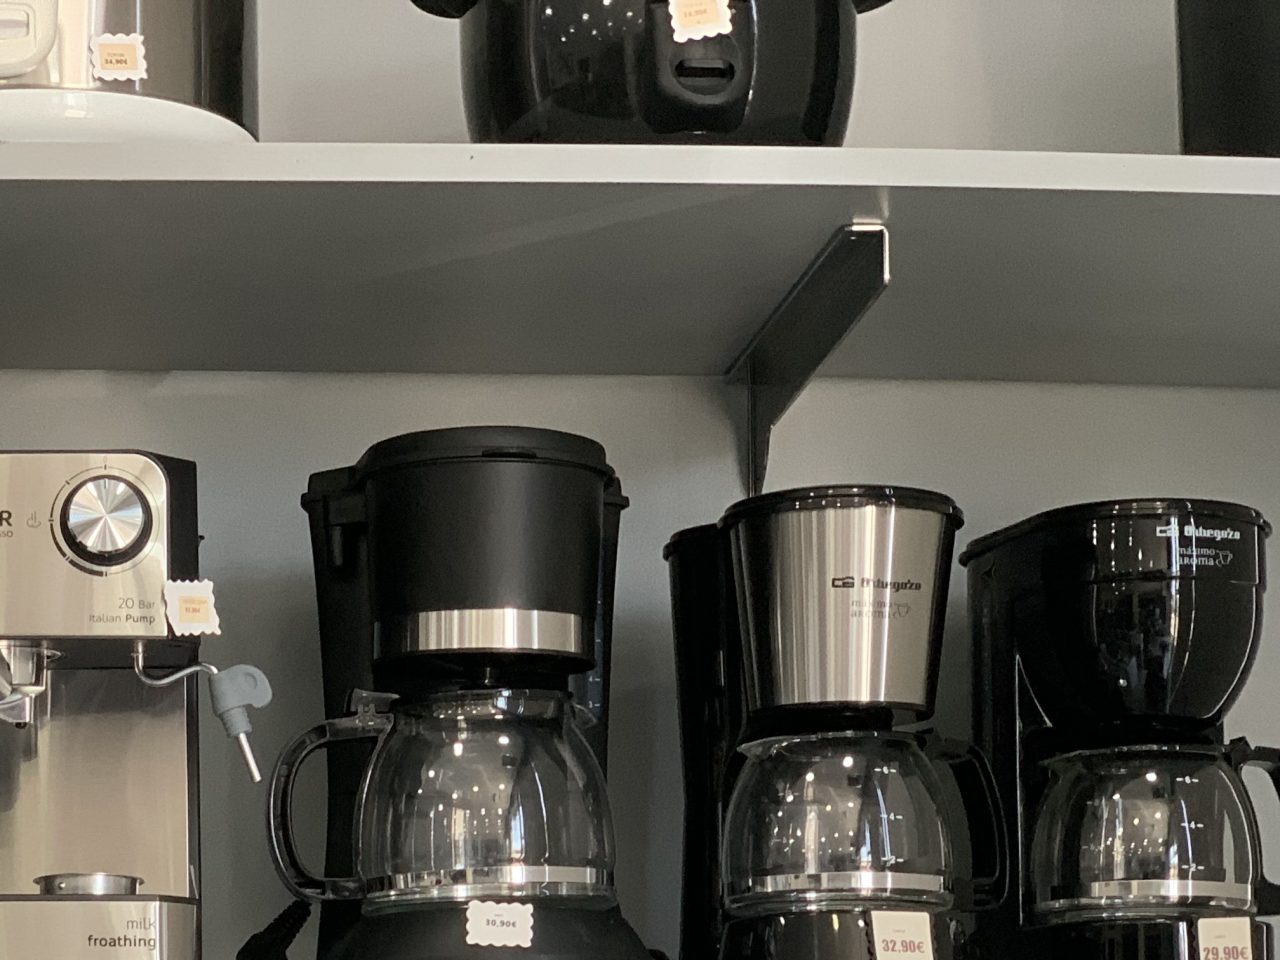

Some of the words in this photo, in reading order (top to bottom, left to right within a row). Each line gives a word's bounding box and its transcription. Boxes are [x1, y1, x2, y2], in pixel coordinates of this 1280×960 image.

[118, 597, 135, 609] 20
[138, 599, 155, 609] Bar
[89, 613, 121, 623] Italian
[125, 614, 156, 625] Pump
[126, 917, 156, 930] milk
[87, 934, 156, 951] froathing
[882, 938, 925, 954] 32,90€
